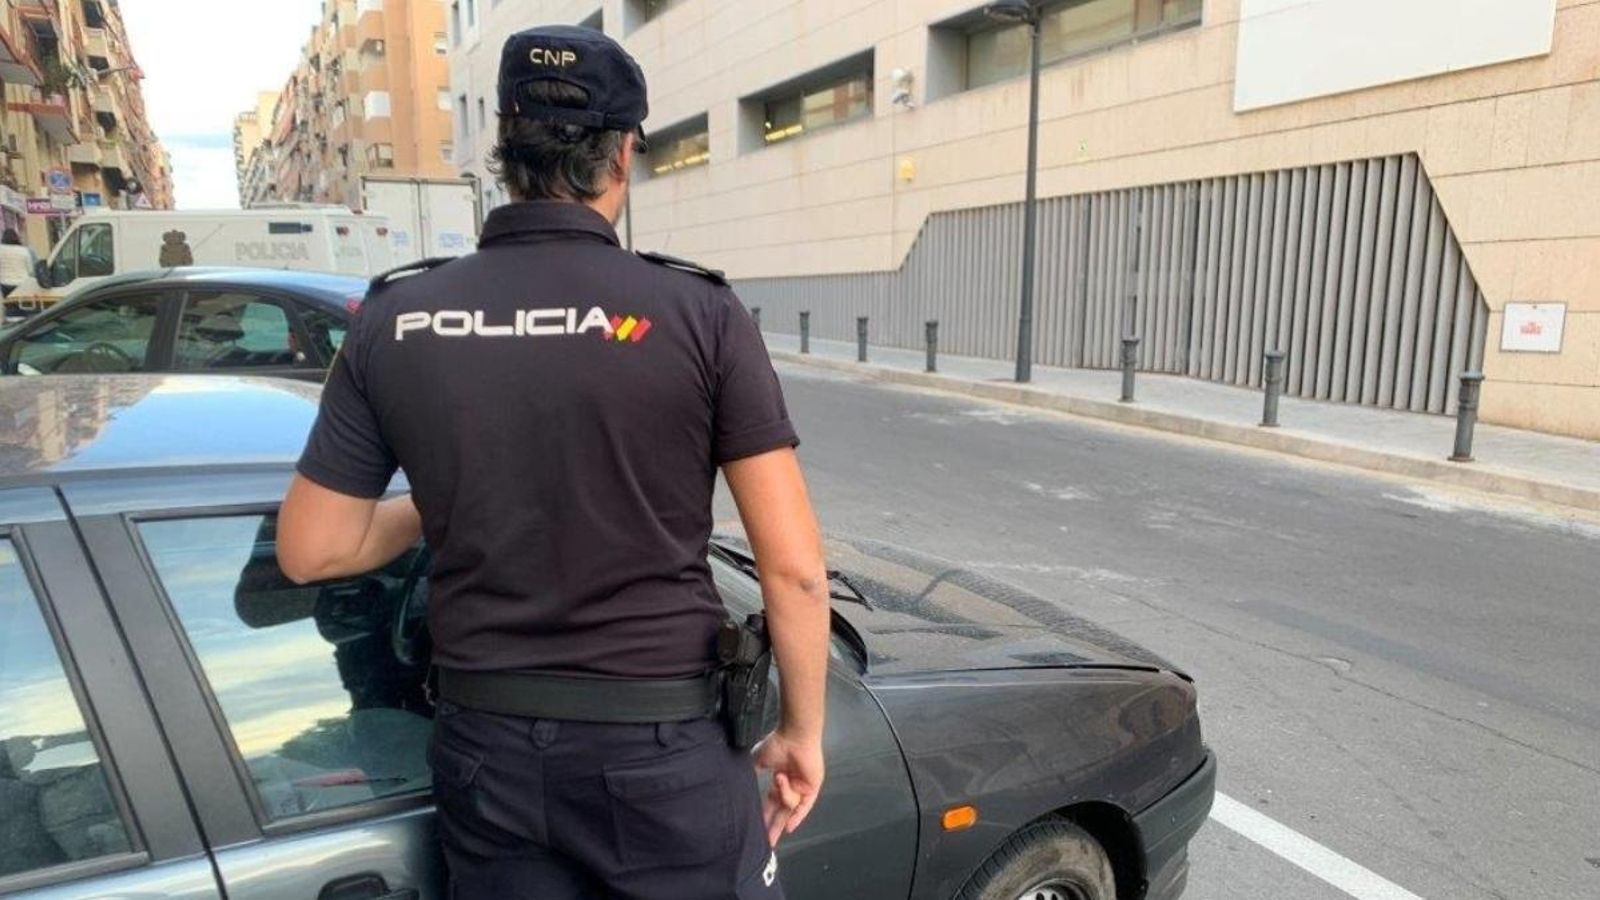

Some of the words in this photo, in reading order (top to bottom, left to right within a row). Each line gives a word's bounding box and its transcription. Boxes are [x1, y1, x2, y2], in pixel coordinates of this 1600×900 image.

[529, 48, 576, 67] CNP
[234, 241, 309, 260] POLICIA
[394, 306, 614, 341] POLICIA
